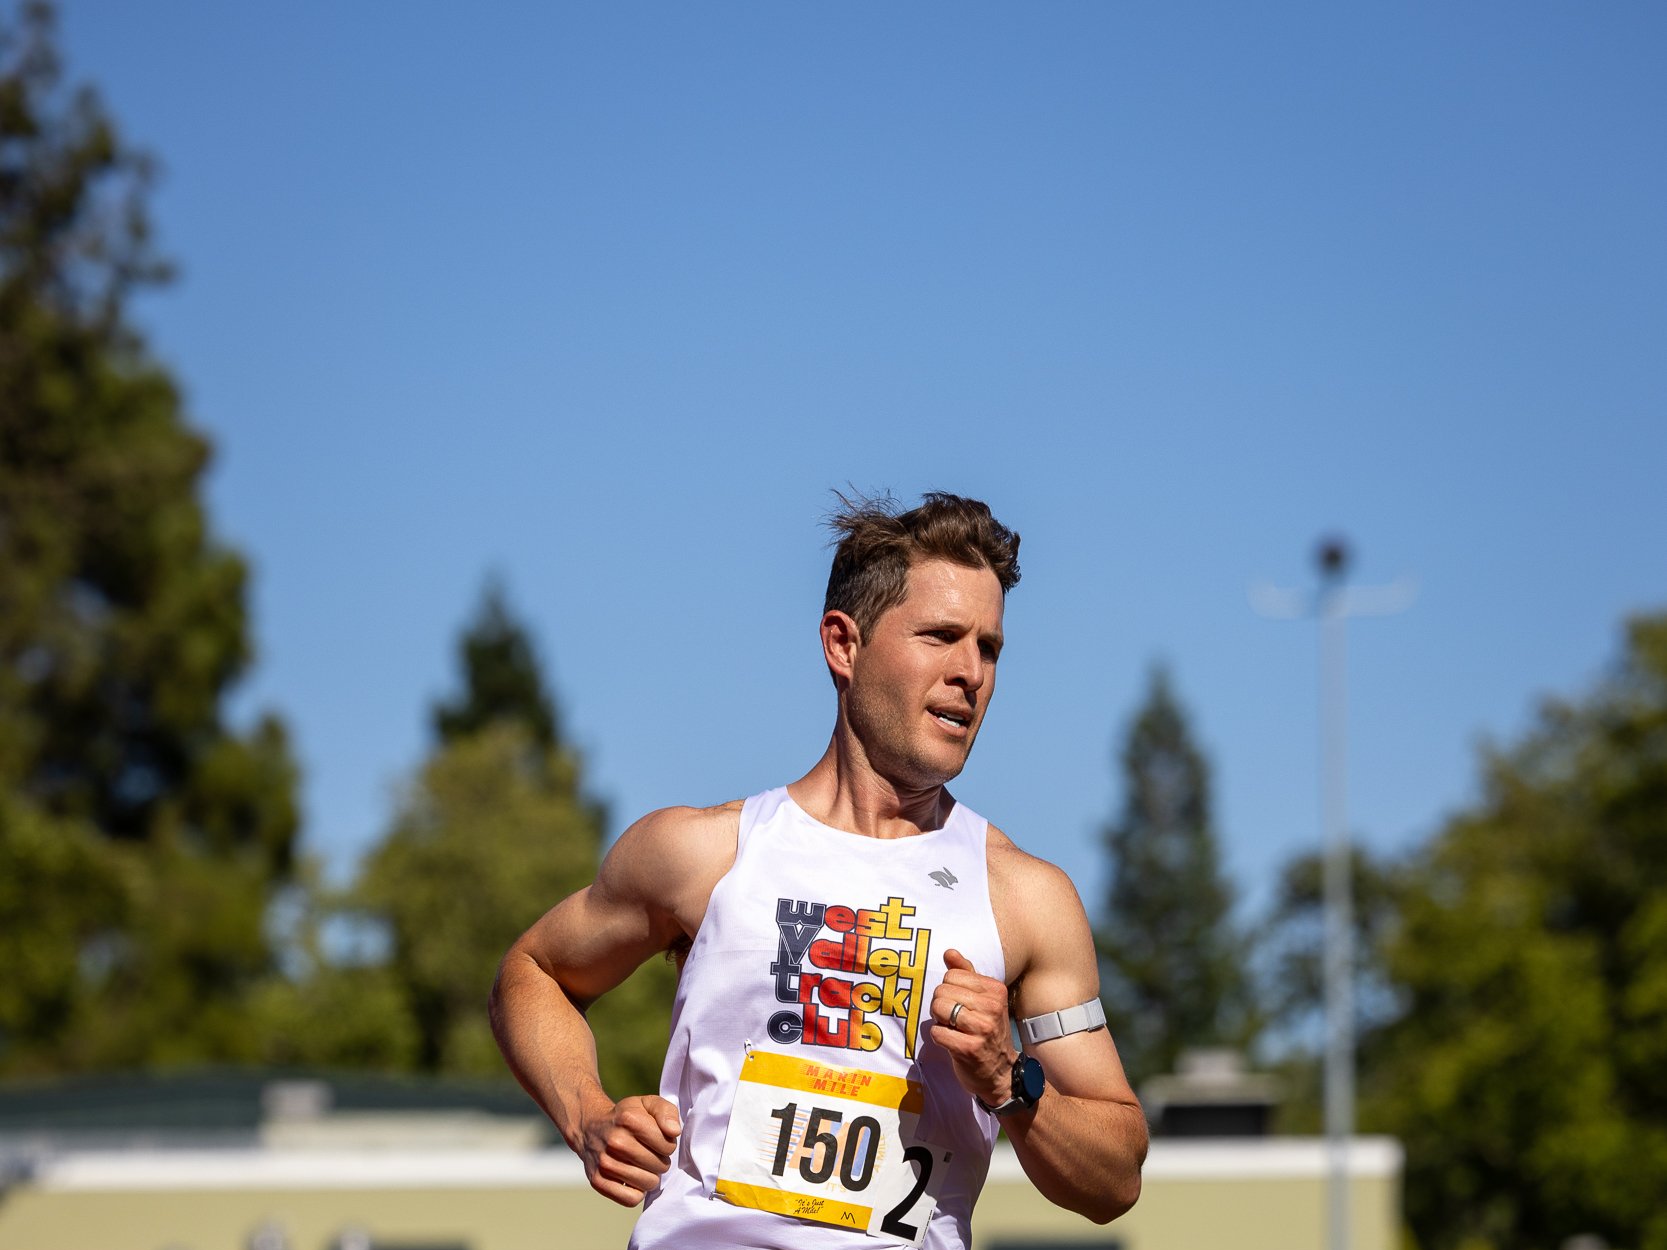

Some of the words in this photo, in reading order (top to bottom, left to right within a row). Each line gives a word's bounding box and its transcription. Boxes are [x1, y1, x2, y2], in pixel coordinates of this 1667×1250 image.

[775, 896, 916, 940] west
[770, 933, 912, 1018] track
[767, 1002, 883, 1052] club
[804, 1064, 872, 1087] MARIN
[811, 1078, 861, 1097] MILE
[771, 1102, 881, 1192] 150
[880, 1146, 934, 1242] 2
